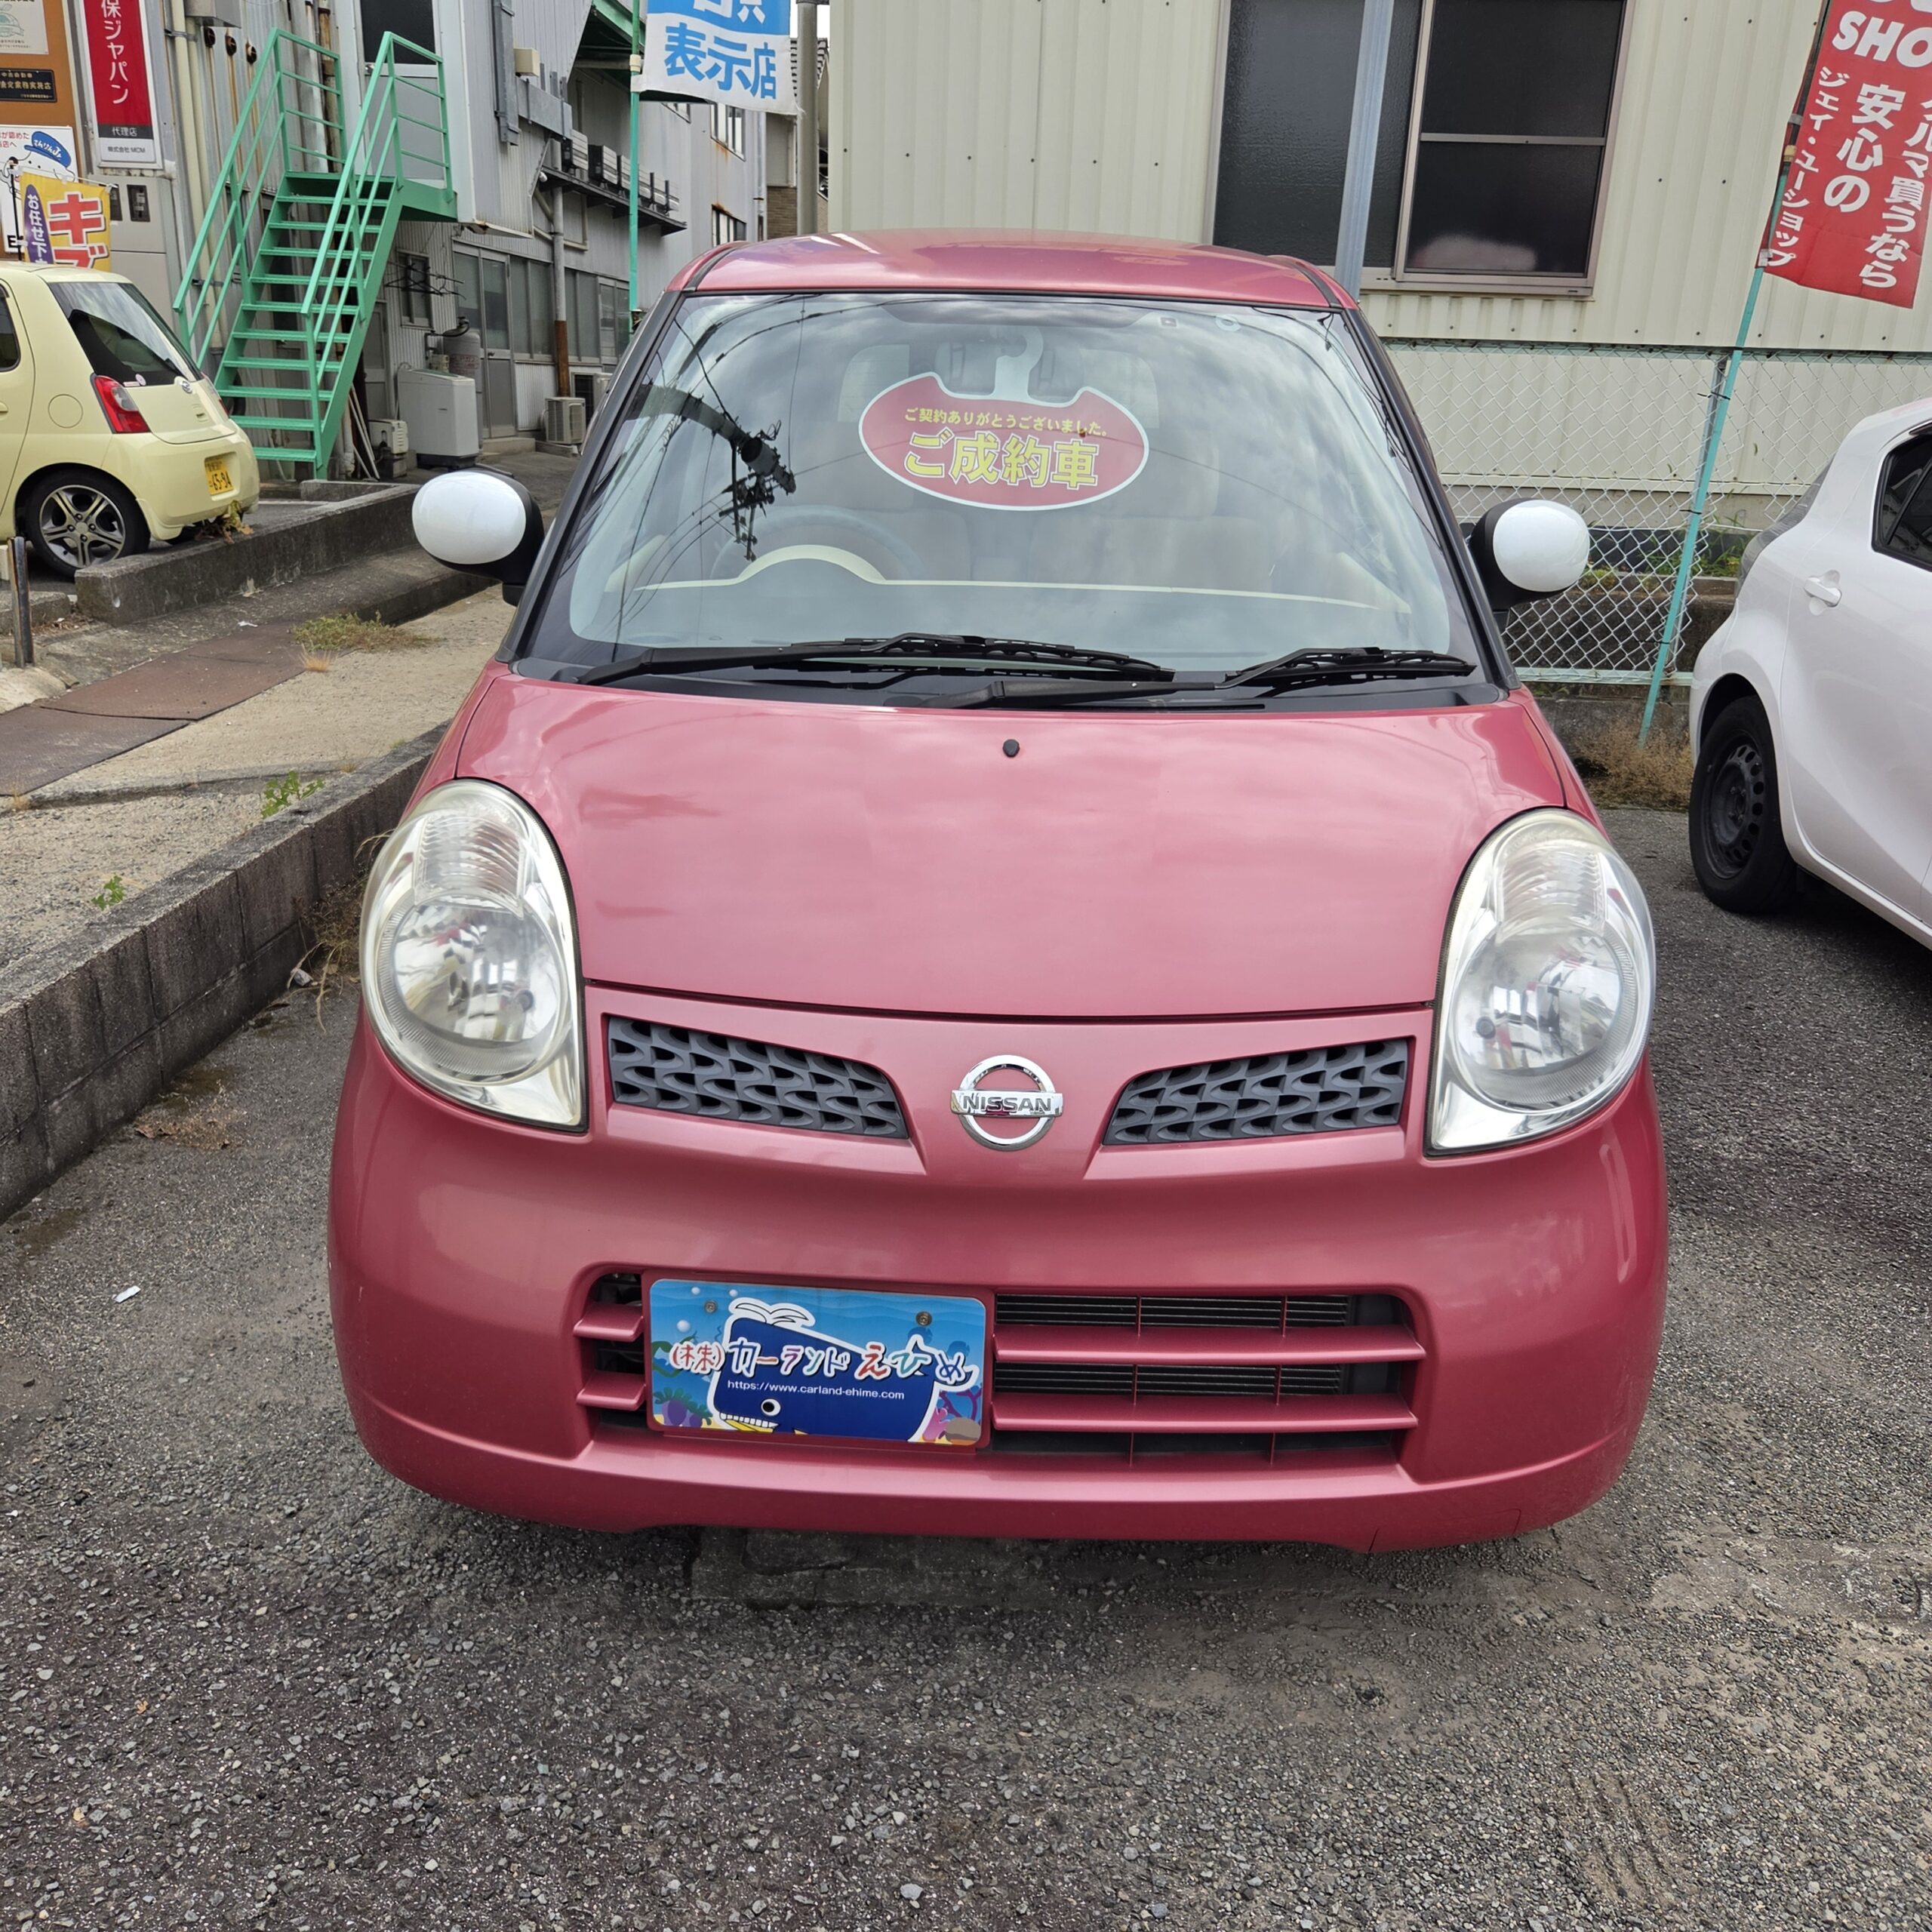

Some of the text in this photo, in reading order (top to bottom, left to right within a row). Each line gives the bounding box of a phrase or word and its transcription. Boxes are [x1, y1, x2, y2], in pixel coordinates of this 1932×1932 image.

[101, 0, 129, 104] 保ジャパン
[664, 23, 777, 100] 表示店
[1832, 11, 1932, 68] SHO
[112, 127, 137, 137] 代理店
[1823, 83, 1906, 213] 安心の
[905, 408, 1108, 437] ご契約ありがとうございました。
[905, 427, 1099, 490] ご成約車
[963, 1096, 1051, 1113] NISSAN
[727, 1380, 905, 1401] https://www.carland-ehime.com
